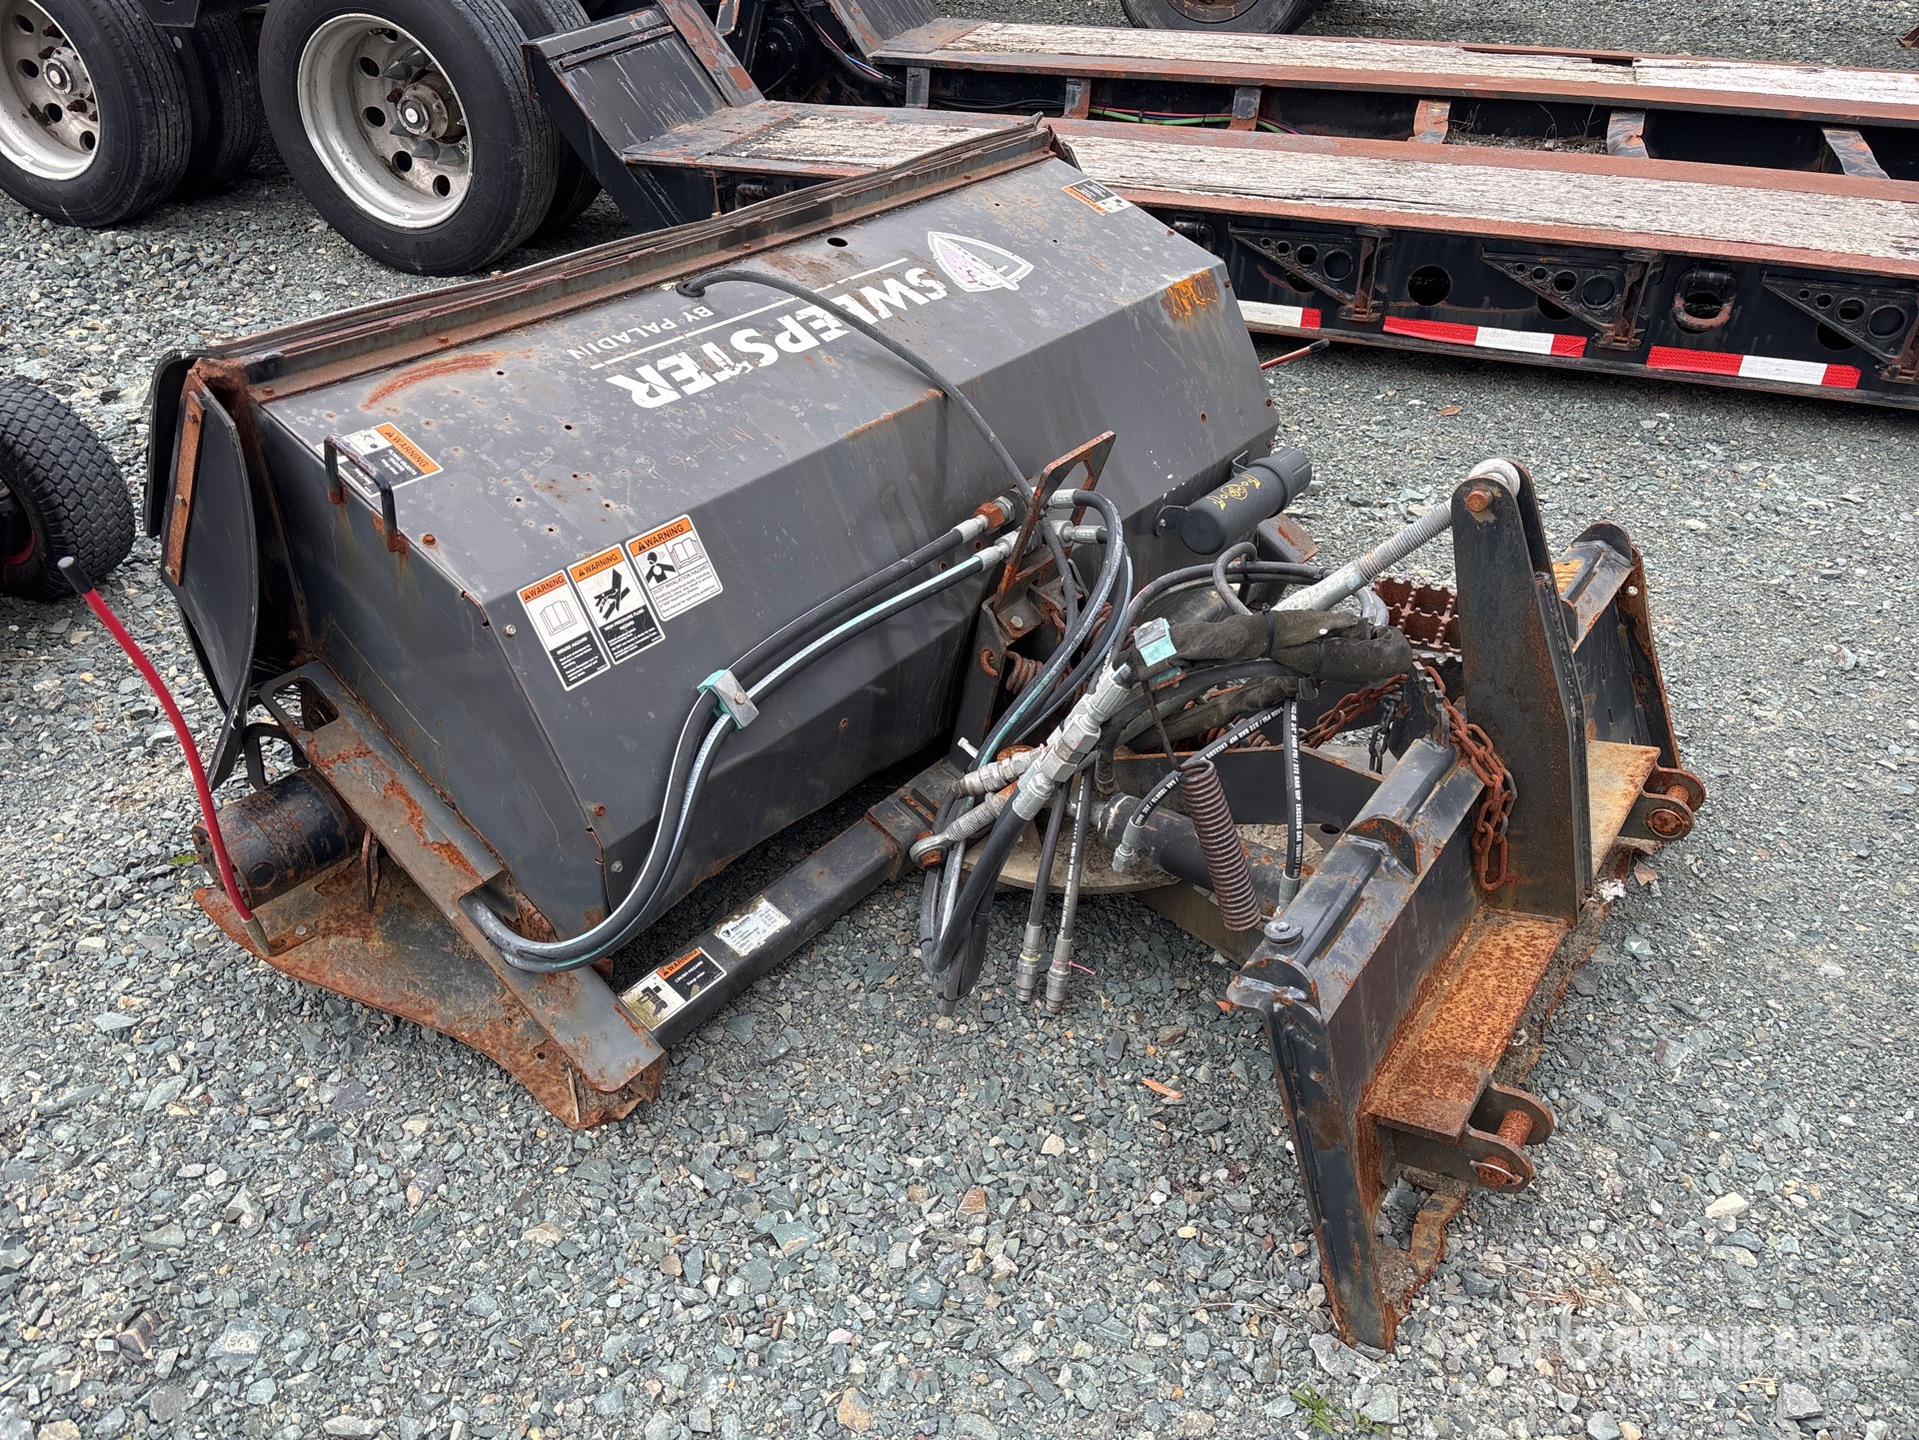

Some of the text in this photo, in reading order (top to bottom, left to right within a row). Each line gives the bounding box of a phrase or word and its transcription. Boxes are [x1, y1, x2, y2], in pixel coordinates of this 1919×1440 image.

[567, 306, 714, 360] BY PALADIN
[392, 435, 429, 468] WARNING
[644, 524, 685, 548] WARNING
[584, 554, 618, 572] WARNING
[529, 577, 565, 600] WARNING
[652, 564, 709, 595] DUST INHALATION HAZARD
[1293, 776, 1301, 789] BAR
